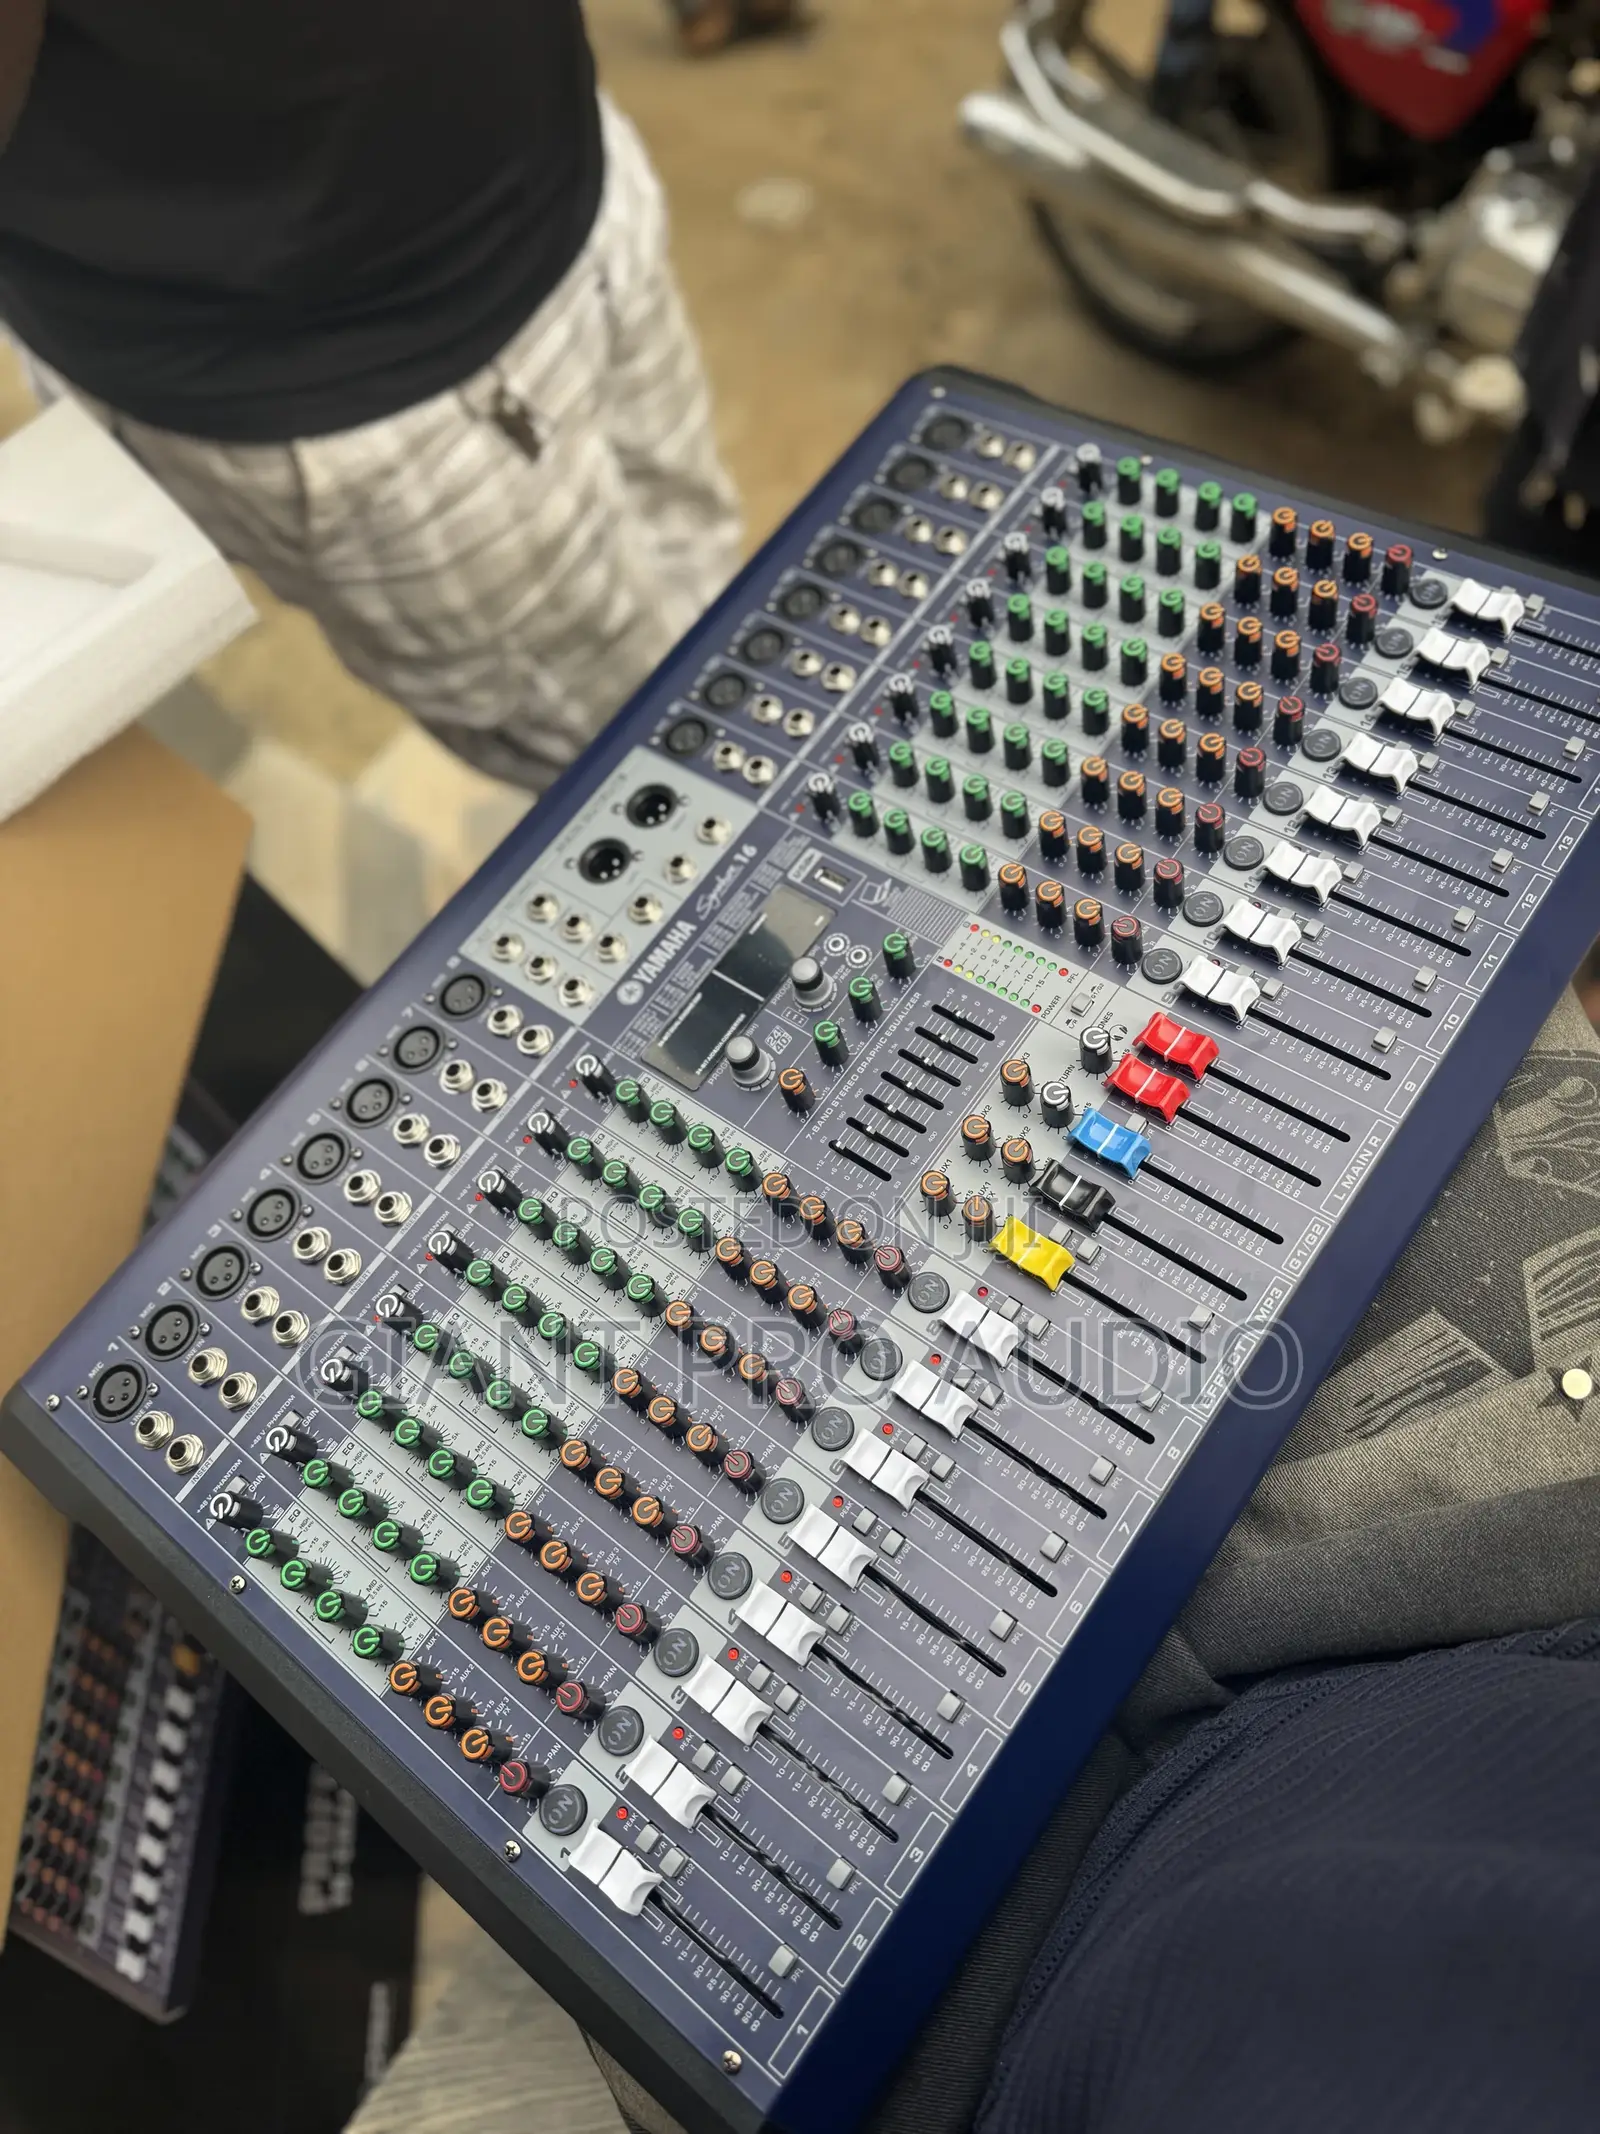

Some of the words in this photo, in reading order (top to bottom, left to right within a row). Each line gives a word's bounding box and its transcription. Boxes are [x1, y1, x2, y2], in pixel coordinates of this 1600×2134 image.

[1271, 785, 1294, 806] ON
[1231, 839, 1255, 862] ON
[1556, 834, 1575, 853] 13
[1191, 895, 1215, 918] ON
[1518, 891, 1538, 911] 12
[631, 916, 698, 986] YAMAHA
[732, 841, 760, 866] 16
[1149, 952, 1173, 976] ON
[1481, 953, 1499, 970] 11
[1066, 970, 1079, 984] PFL
[1040, 994, 1061, 1019] POWER
[1441, 1012, 1461, 1032] 10
[830, 1072, 860, 1107] STEREO
[855, 1036, 888, 1074] GRAPHIC
[884, 991, 923, 1037] EQUALIZER
[1392, 1043, 1404, 1055] PFL
[1402, 1079, 1417, 1093] 9
[1332, 1189, 1346, 1201] L
[1340, 1146, 1374, 1189] MAIN
[1366, 1133, 1382, 1148] R
[546, 1190, 560, 1204] EQ
[421, 1209, 449, 1241] PHANTOM
[455, 1220, 473, 1240] GAIN
[1287, 1221, 1326, 1271] G1/G2
[497, 1250, 511, 1264] EQ
[156, 1280, 172, 1296] 2
[370, 1270, 399, 1302] PHANTOM
[139, 1301, 156, 1319] MIC
[1254, 1286, 1283, 1323] MP3
[446, 1312, 460, 1327] EQ
[106, 1341, 119, 1355] 1
[182, 1347, 198, 1365] LINE
[195, 1337, 206, 1349] IN
[87, 1360, 105, 1379] MIC
[1198, 1340, 1249, 1410] EFFECT
[394, 1376, 408, 1391] EQ
[129, 1408, 145, 1426] LINE
[143, 1398, 154, 1410] IN
[243, 1393, 267, 1420] INSERT
[266, 1394, 296, 1428] PHANTOM
[301, 1406, 320, 1428] GAIN
[586, 1422, 599, 1437] AUX
[818, 1412, 844, 1442] ON
[341, 1440, 356, 1456] EQ
[621, 1450, 634, 1464] AUX
[762, 1442, 777, 1459] PAN
[1165, 1444, 1182, 1461] 8
[189, 1456, 214, 1485] INSERT
[212, 1458, 242, 1493] PHANTOM
[247, 1471, 266, 1493] GAIN
[656, 1478, 669, 1493] AUX
[1110, 1474, 1123, 1489] PFL
[768, 1485, 795, 1515] ON
[839, 1500, 854, 1518] PEAK
[287, 1507, 302, 1523] EQ
[710, 1514, 726, 1532] PAN
[870, 1524, 884, 1540] L/R
[1117, 1521, 1133, 1537] 7
[894, 1542, 913, 1564] G1/G2
[1061, 1551, 1074, 1566] PFL
[480, 1563, 493, 1578] AUX
[715, 1559, 742, 1591] ON
[787, 1575, 803, 1594] PEAK
[514, 1593, 527, 1608] AUX
[657, 1589, 673, 1607] PAN
[1068, 1598, 1084, 1616] 6
[819, 1600, 833, 1616] L/R
[549, 1624, 563, 1640] AUX
[842, 1619, 861, 1642] G1/G2
[1010, 1629, 1024, 1645] PFL
[424, 1635, 438, 1651] AUX
[660, 1635, 688, 1668] ON
[734, 1653, 750, 1672] PEAK
[458, 1667, 472, 1683] AUX
[602, 1664, 618, 1683] PAN
[765, 1678, 779, 1695] L/R
[1016, 1678, 1032, 1696] 5
[493, 1699, 507, 1716] AUX
[788, 1698, 807, 1723] G1/G2
[958, 1709, 971, 1726] PFL
[605, 1715, 632, 1748] ON
[679, 1731, 695, 1751] PEAK
[546, 1741, 562, 1760] PAN
[710, 1758, 724, 1776] L/R
[962, 1760, 979, 1779] 4
[733, 1779, 752, 1804] G1/G2
[904, 1792, 917, 1809] PFL
[546, 1792, 574, 1827] ON
[622, 1811, 638, 1832] PEAK
[653, 1839, 668, 1858] L/R
[908, 1844, 925, 1864] 3
[676, 1861, 696, 1887] G1/G2
[848, 1877, 862, 1895] PFL
[660, 1932, 673, 1948] 10
[851, 1931, 868, 1952] 2
[676, 1948, 689, 1964] 15
[692, 1963, 705, 1979] 20
[790, 1964, 805, 1983] PFL
[705, 1975, 718, 1992] 25
[719, 1988, 732, 2004] 30
[732, 2000, 745, 2017] 40
[740, 2008, 753, 2025] 60
[795, 2022, 809, 2039] 1
